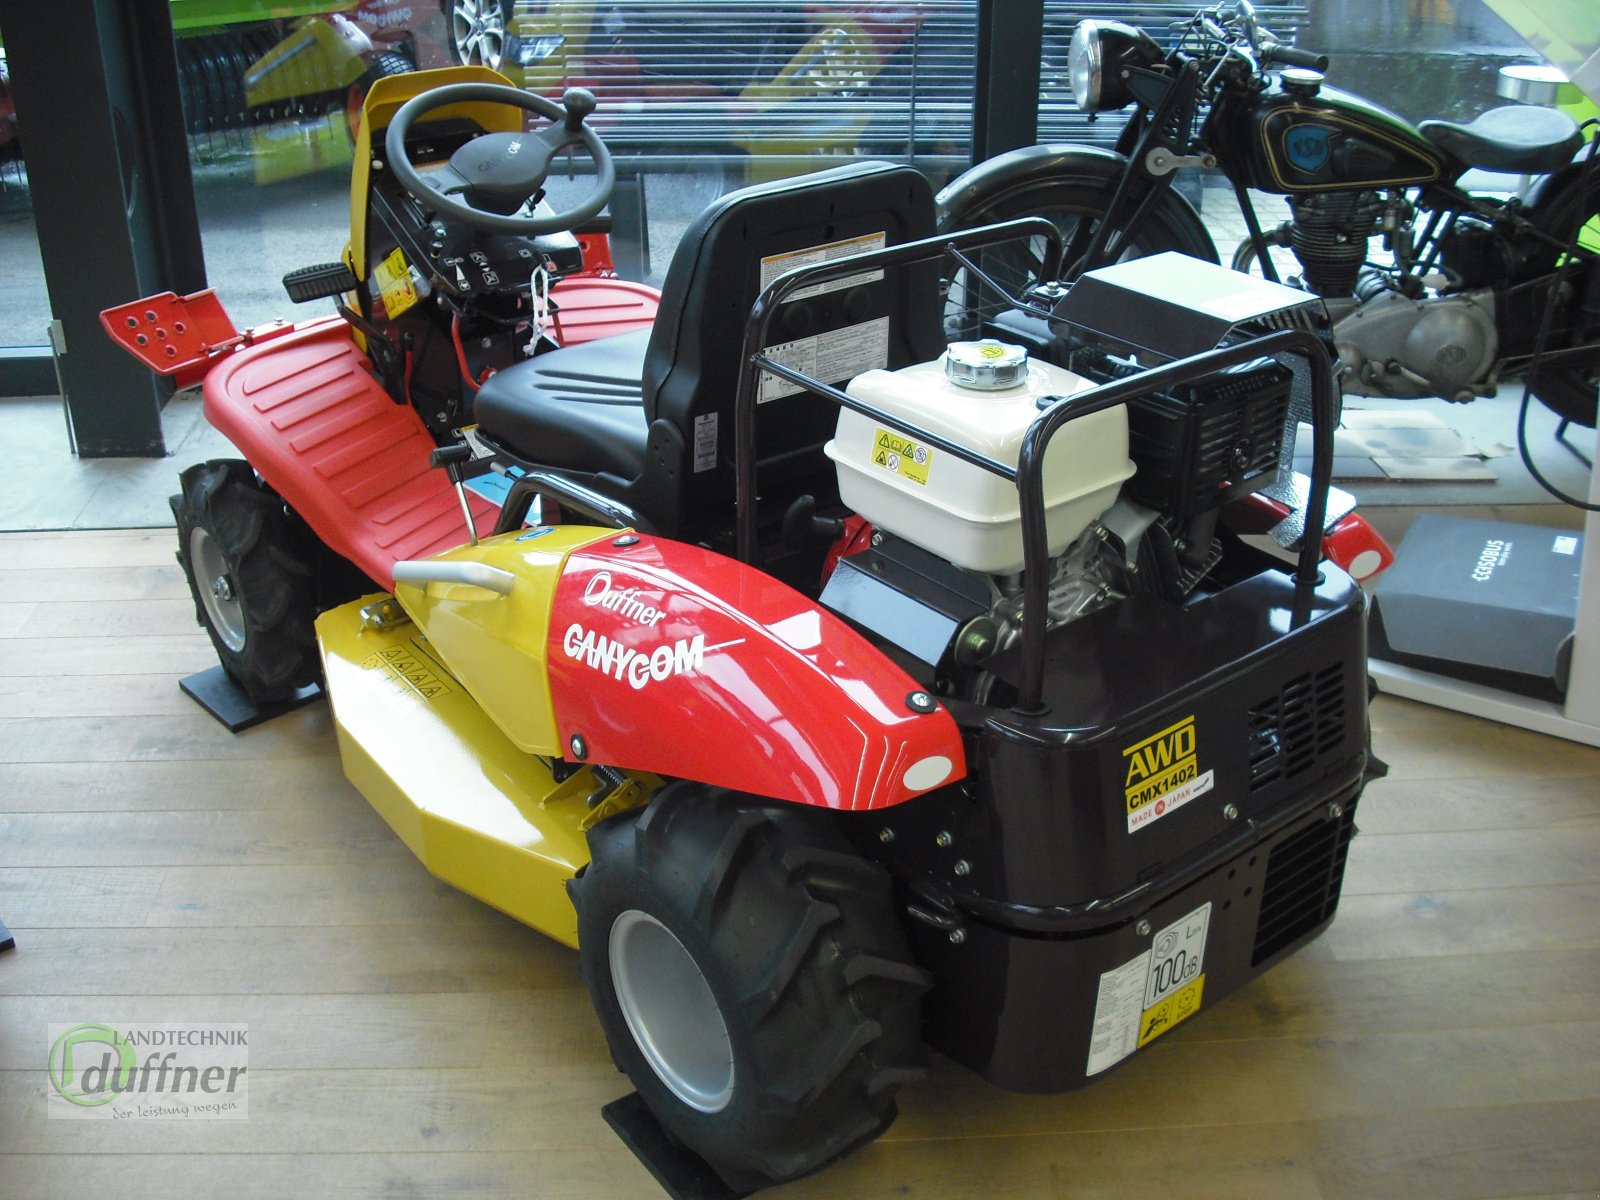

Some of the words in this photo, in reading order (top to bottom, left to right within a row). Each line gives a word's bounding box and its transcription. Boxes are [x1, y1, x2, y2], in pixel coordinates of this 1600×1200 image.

[583, 571, 667, 627] Duffner
[563, 623, 705, 690] CANYCOM
[1125, 724, 1196, 788] AWD
[1129, 764, 1195, 810] CMX1402
[1131, 809, 1152, 826] MADE
[1167, 788, 1191, 807] JAPAN
